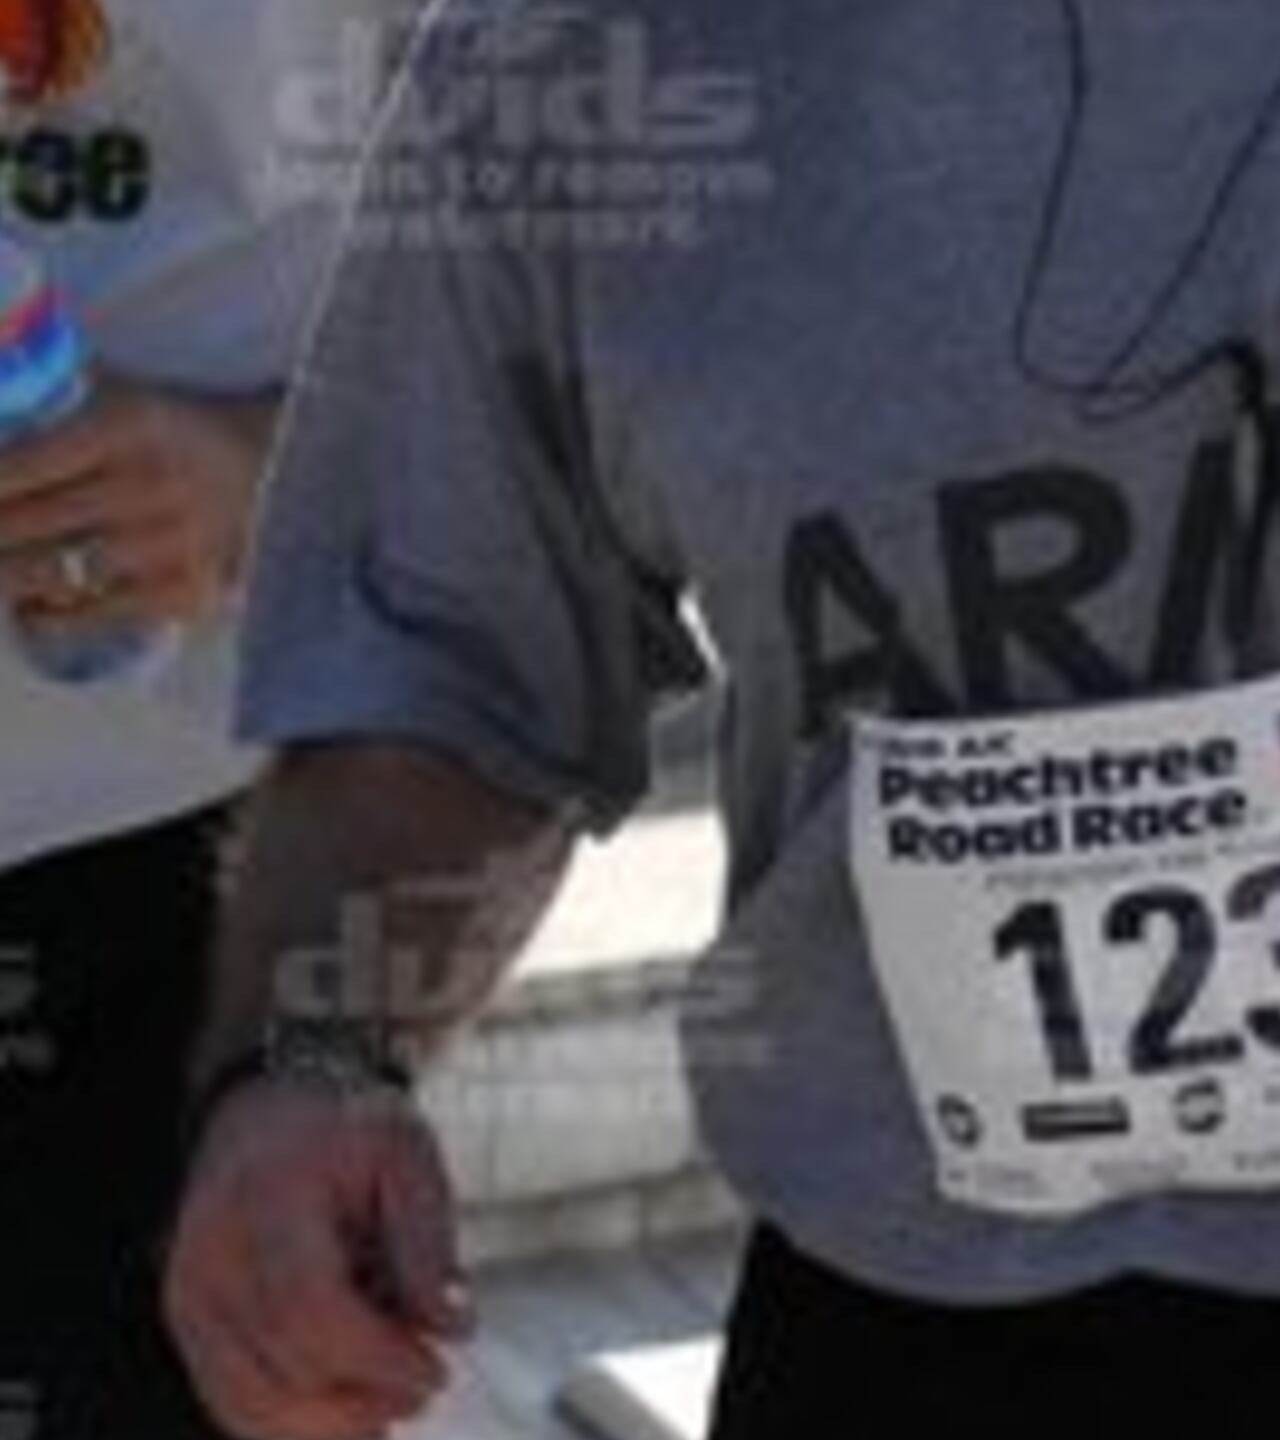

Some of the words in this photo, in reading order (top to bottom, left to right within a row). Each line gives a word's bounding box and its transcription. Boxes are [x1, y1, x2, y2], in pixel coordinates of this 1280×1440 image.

[879, 736, 1238, 810] Peachtree
[888, 810, 1061, 862] Road
[1073, 789, 1247, 850] Race
